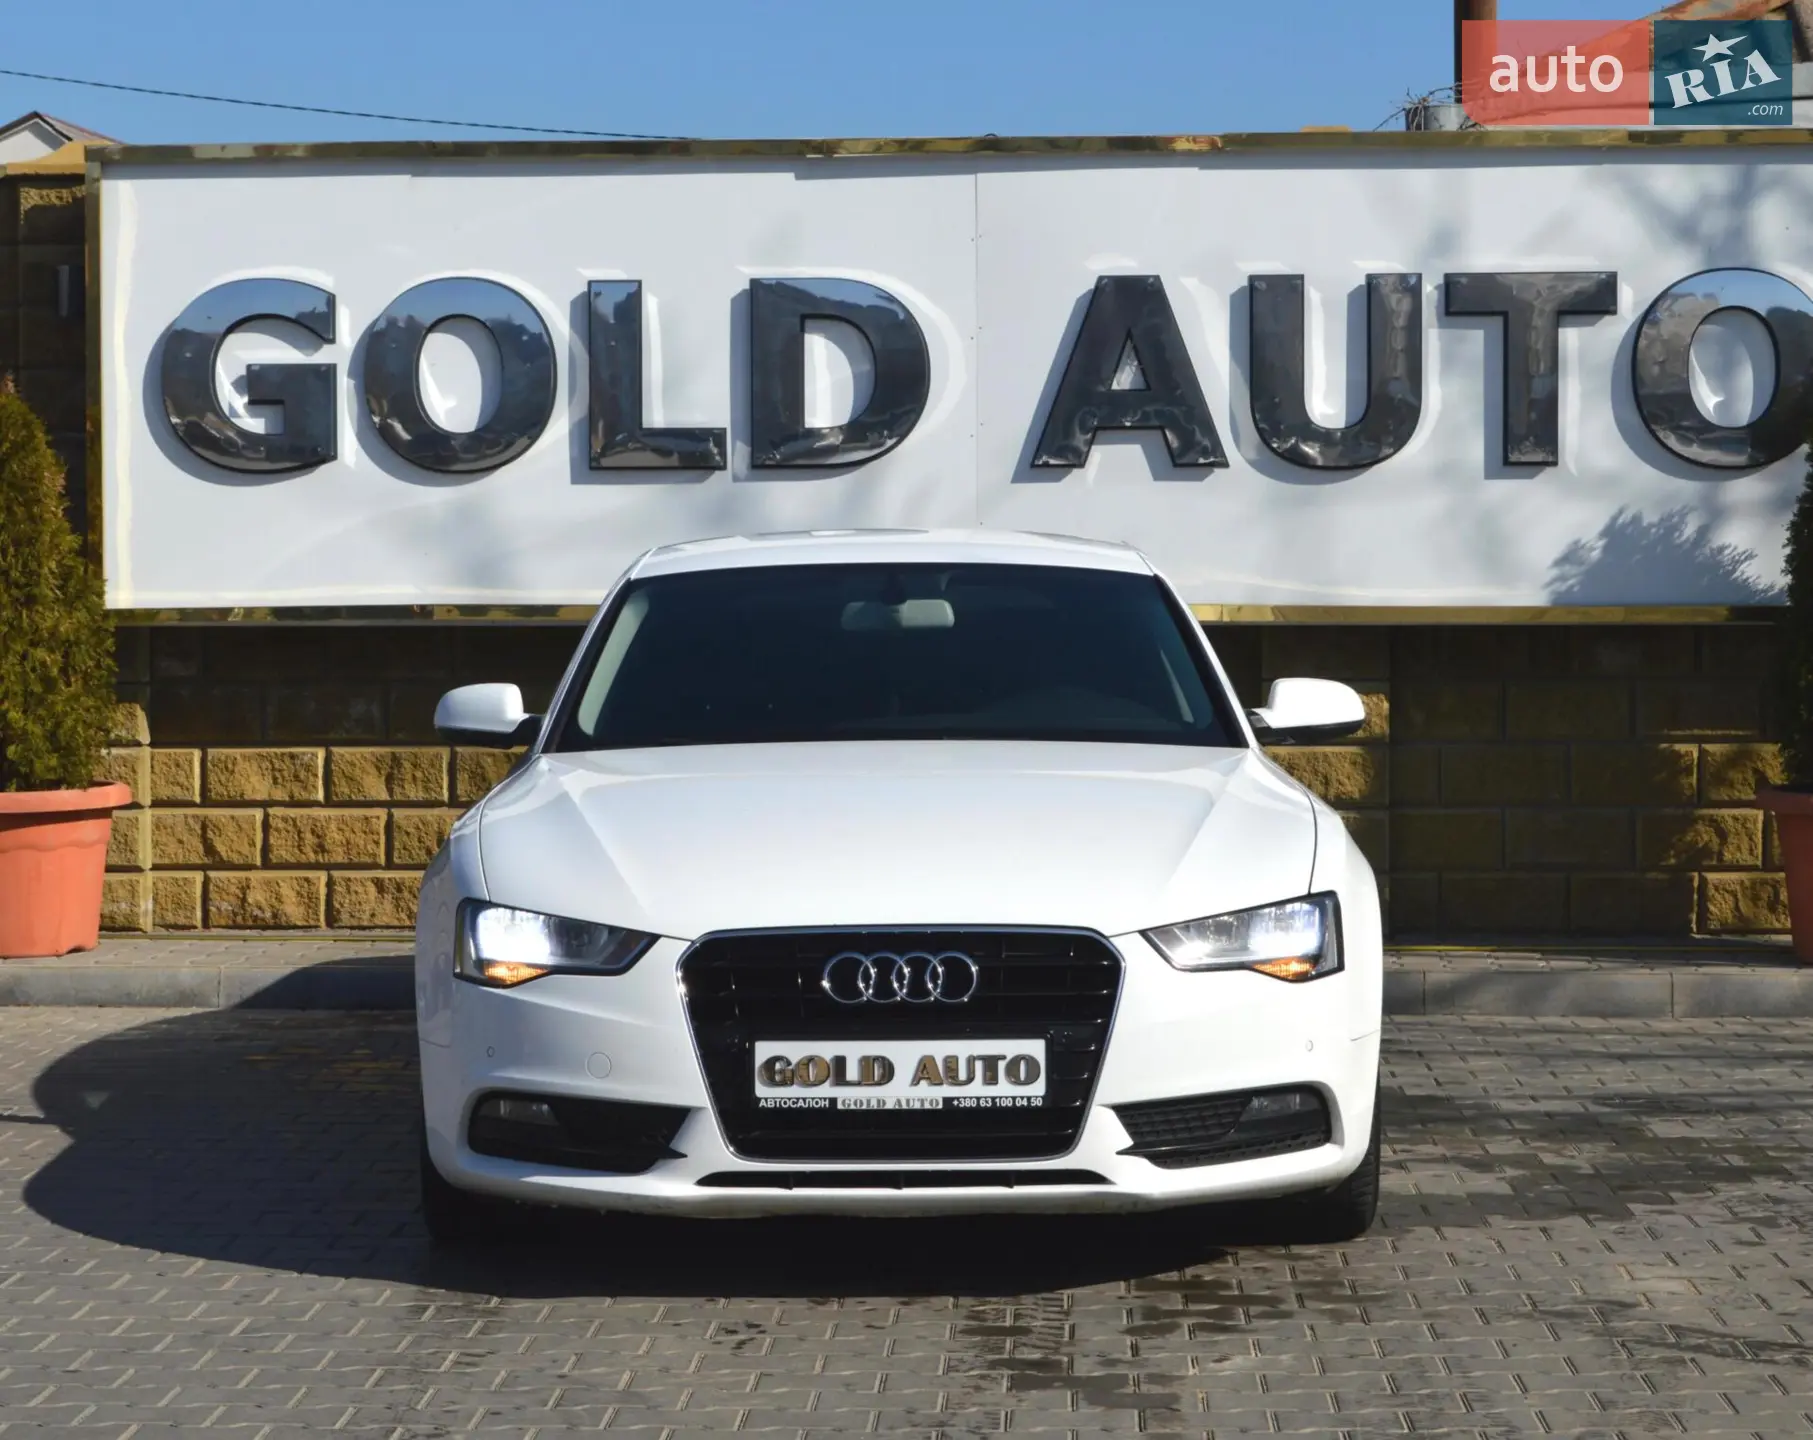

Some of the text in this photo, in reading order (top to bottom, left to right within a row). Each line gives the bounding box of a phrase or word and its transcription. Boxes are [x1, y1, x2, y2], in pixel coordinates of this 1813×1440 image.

[161, 267, 1813, 473] GOLD AUTO
[757, 1054, 1042, 1087] GOLD AUTO
[758, 1096, 1043, 1109] АВТОСАЛОН GOLD AUTO +380 63 100 04 50
